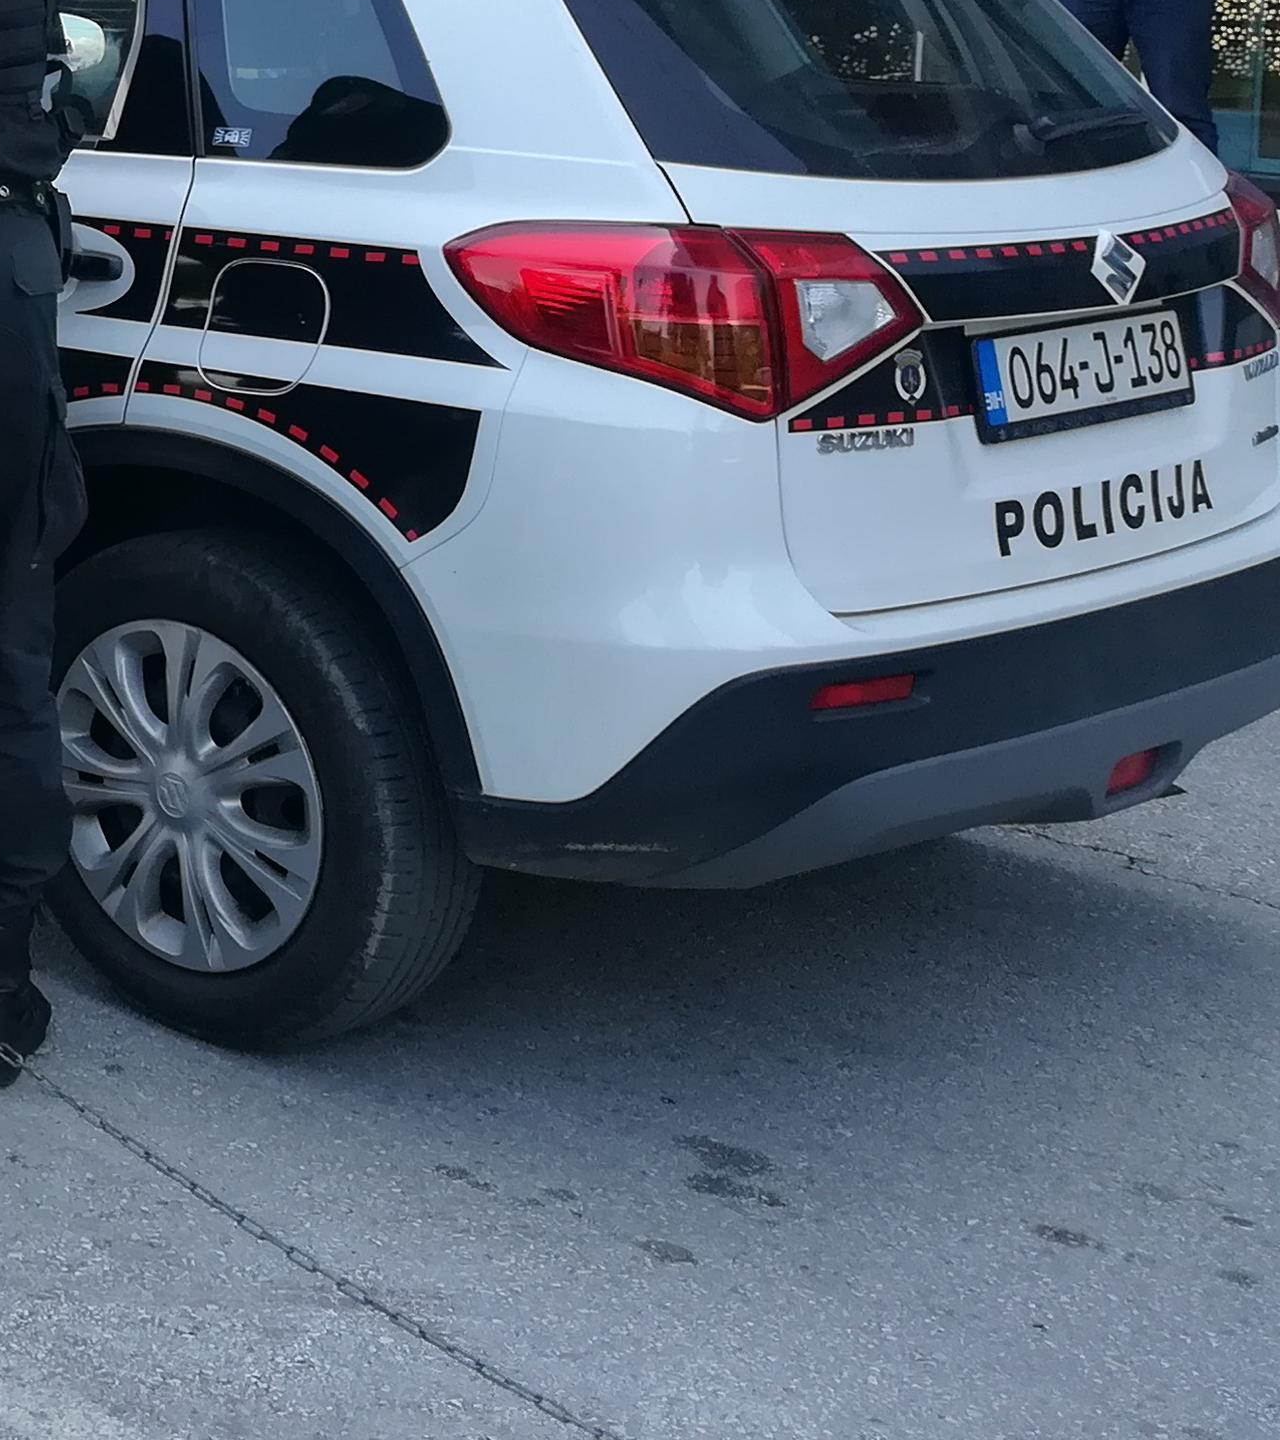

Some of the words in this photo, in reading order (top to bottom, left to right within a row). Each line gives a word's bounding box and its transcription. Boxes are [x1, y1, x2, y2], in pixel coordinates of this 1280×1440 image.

[1008, 320, 1181, 409] 064-J-138
[816, 427, 914, 454] SUZUKI
[995, 459, 1213, 557] POLICIJA
